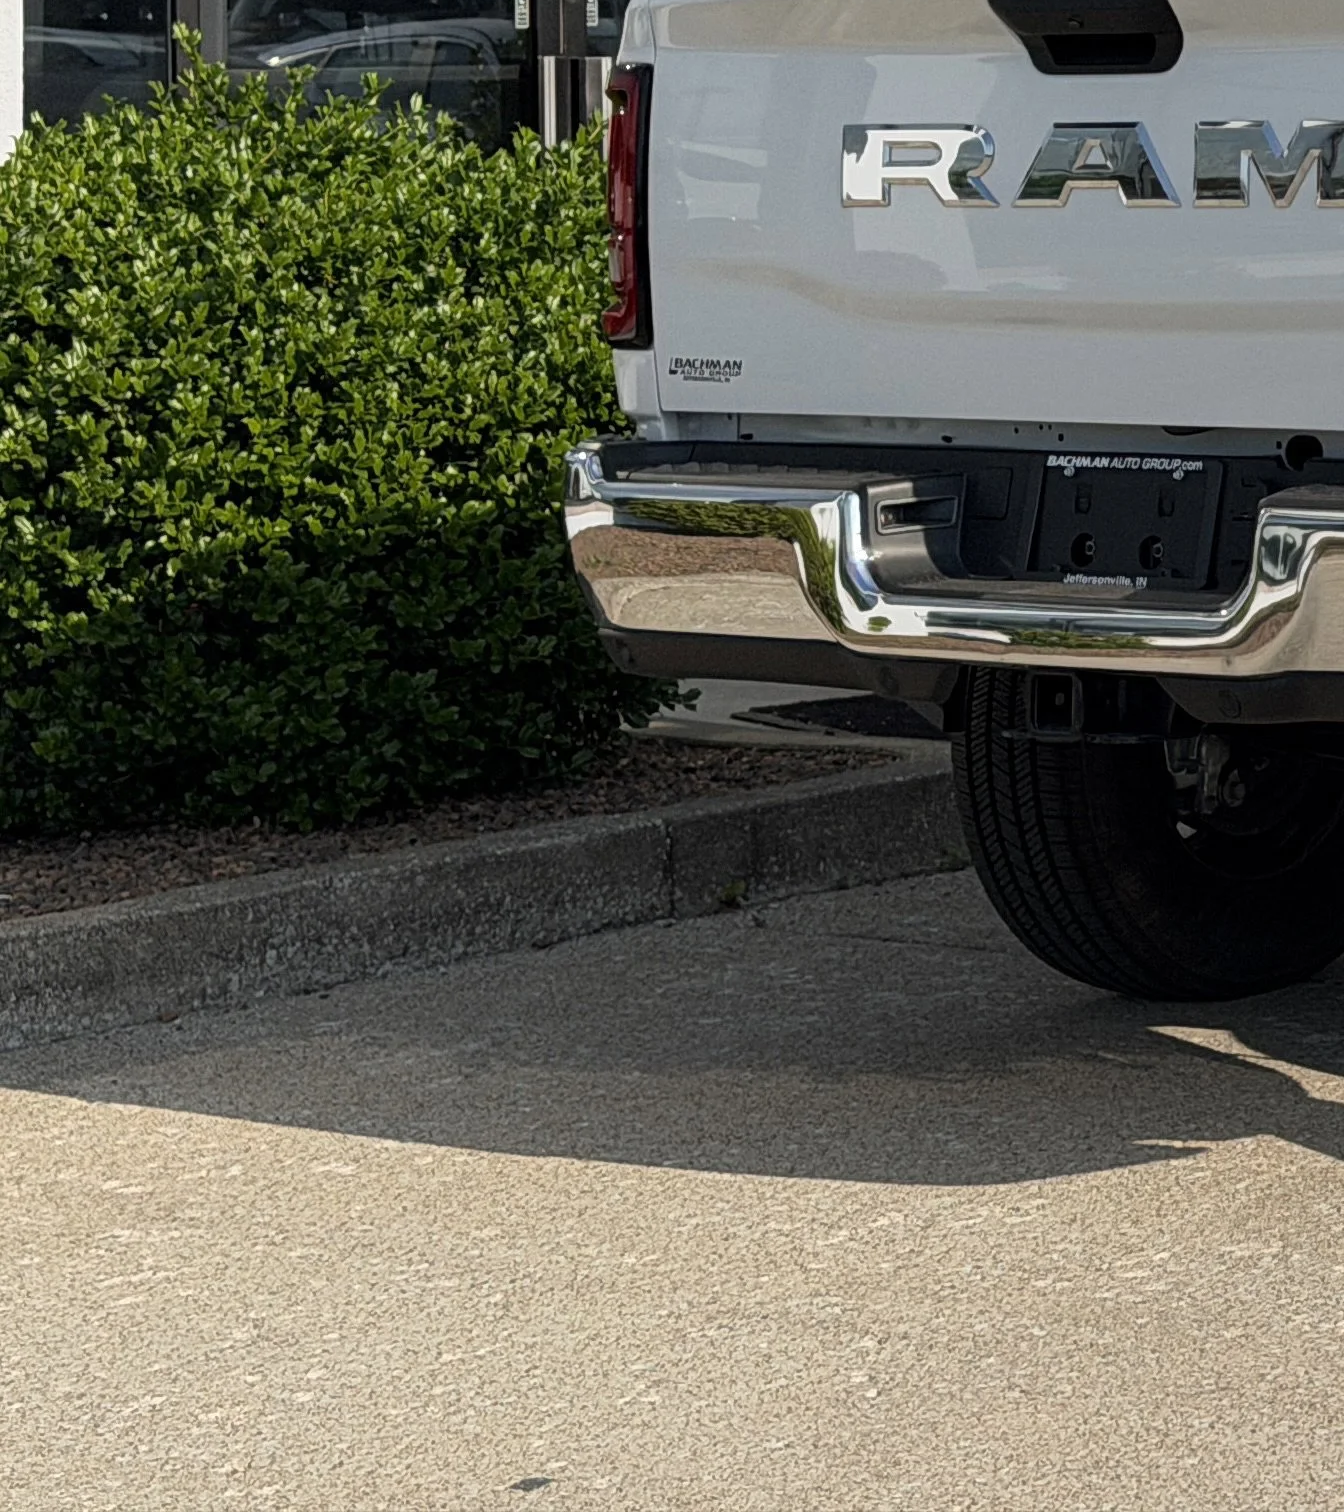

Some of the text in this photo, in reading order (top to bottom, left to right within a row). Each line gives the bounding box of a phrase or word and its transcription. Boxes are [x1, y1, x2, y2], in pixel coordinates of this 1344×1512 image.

[674, 357, 743, 370] BACHMAN
[1046, 455, 1203, 471] BACHMAN AUTO GROUP.com
[1063, 573, 1133, 586] Jeffersonville,
